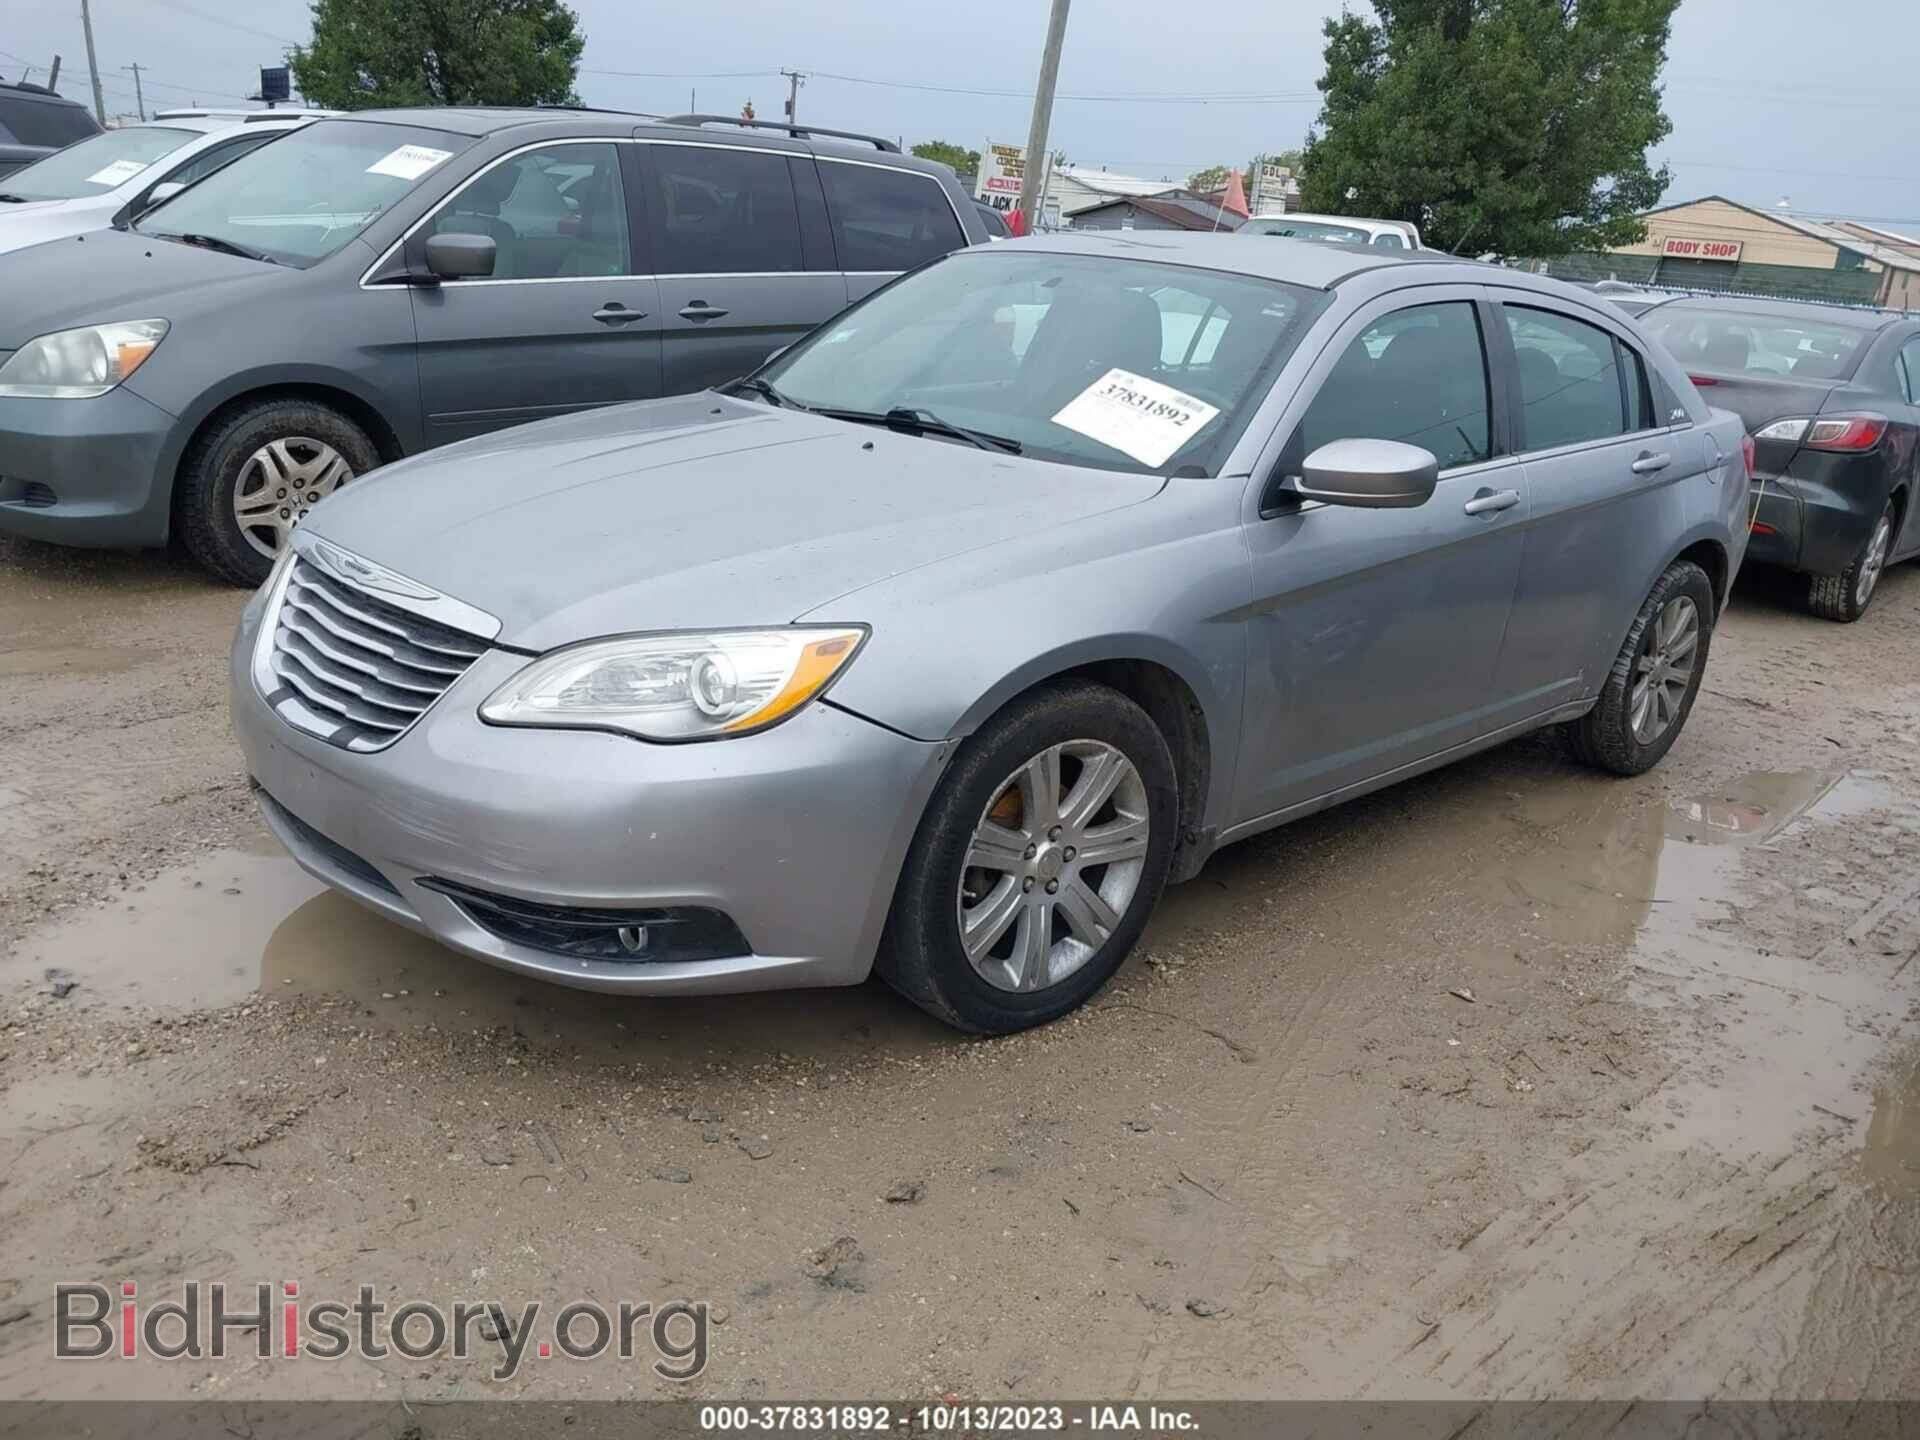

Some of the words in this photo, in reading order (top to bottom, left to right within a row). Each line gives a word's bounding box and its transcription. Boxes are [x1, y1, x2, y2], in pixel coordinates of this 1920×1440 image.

[1666, 240, 1701, 255] BODY
[1702, 243, 1737, 257] SHOP
[1099, 383, 1191, 427] 37831892
